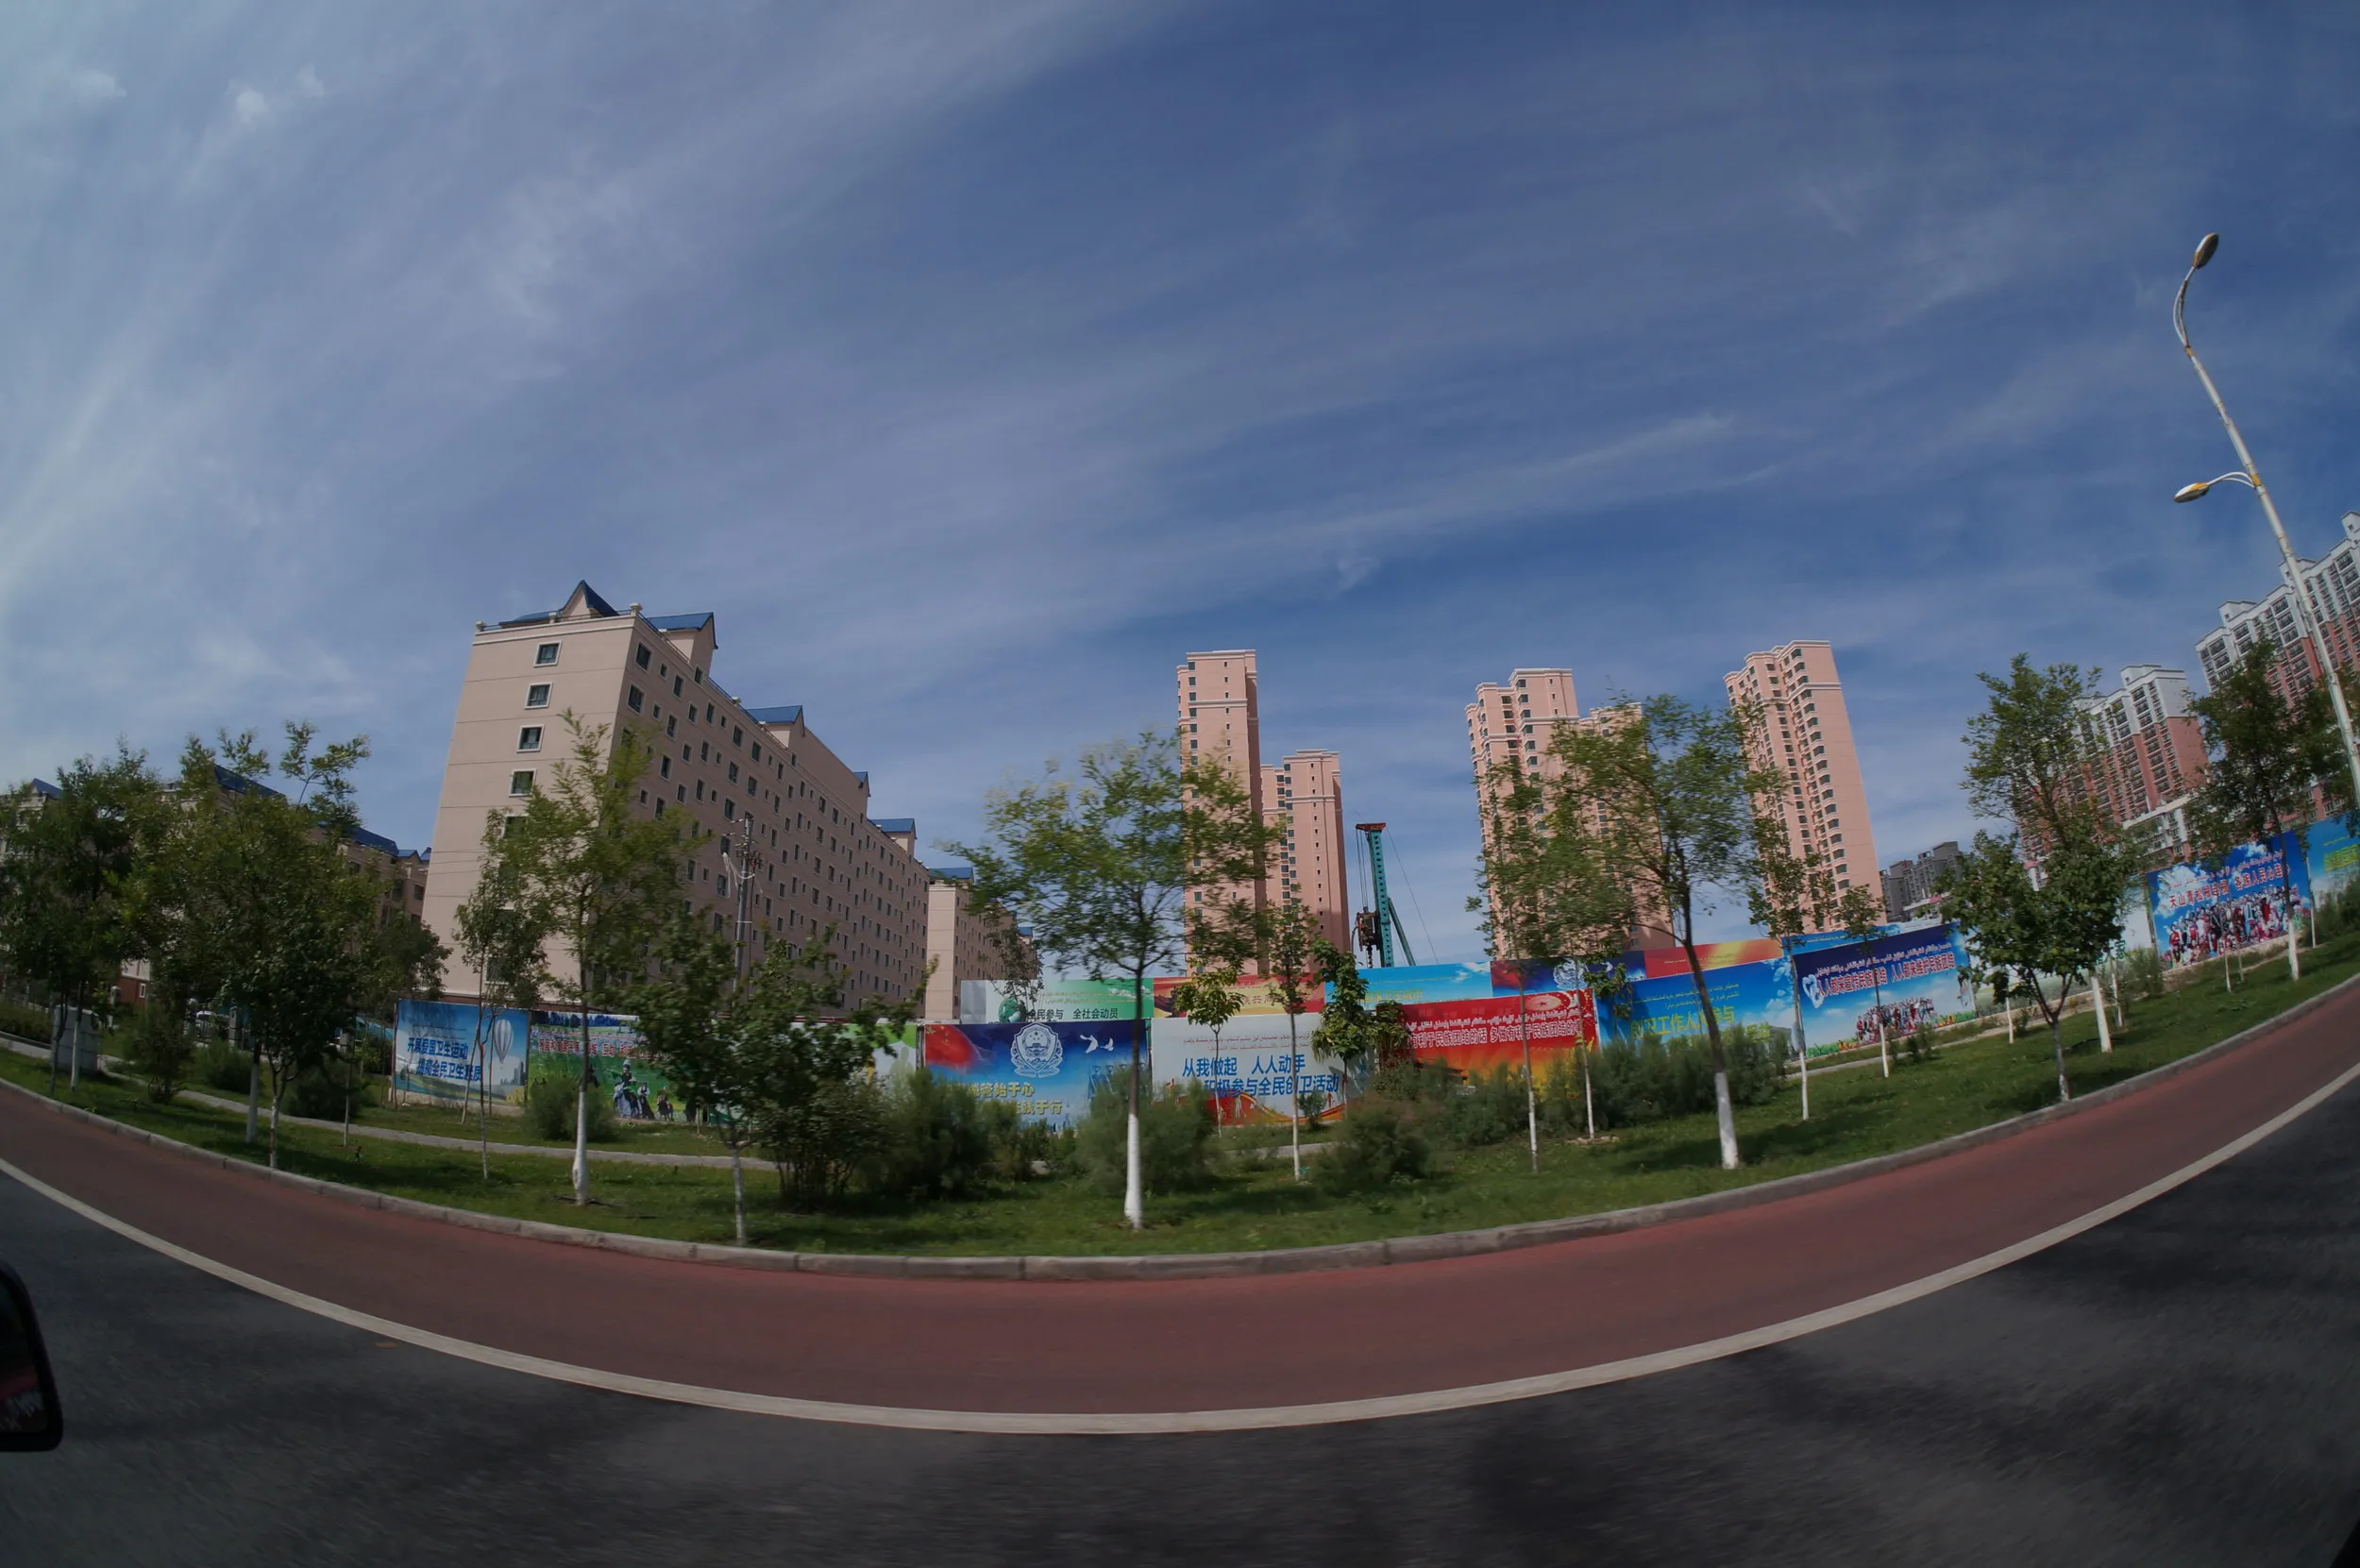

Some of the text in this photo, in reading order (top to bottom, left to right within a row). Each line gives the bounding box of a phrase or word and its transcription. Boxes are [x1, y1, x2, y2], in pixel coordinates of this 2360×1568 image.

[1072, 1007, 1119, 1020] 全社会动员
[1182, 1054, 1306, 1077] 从我做起 人人动手
